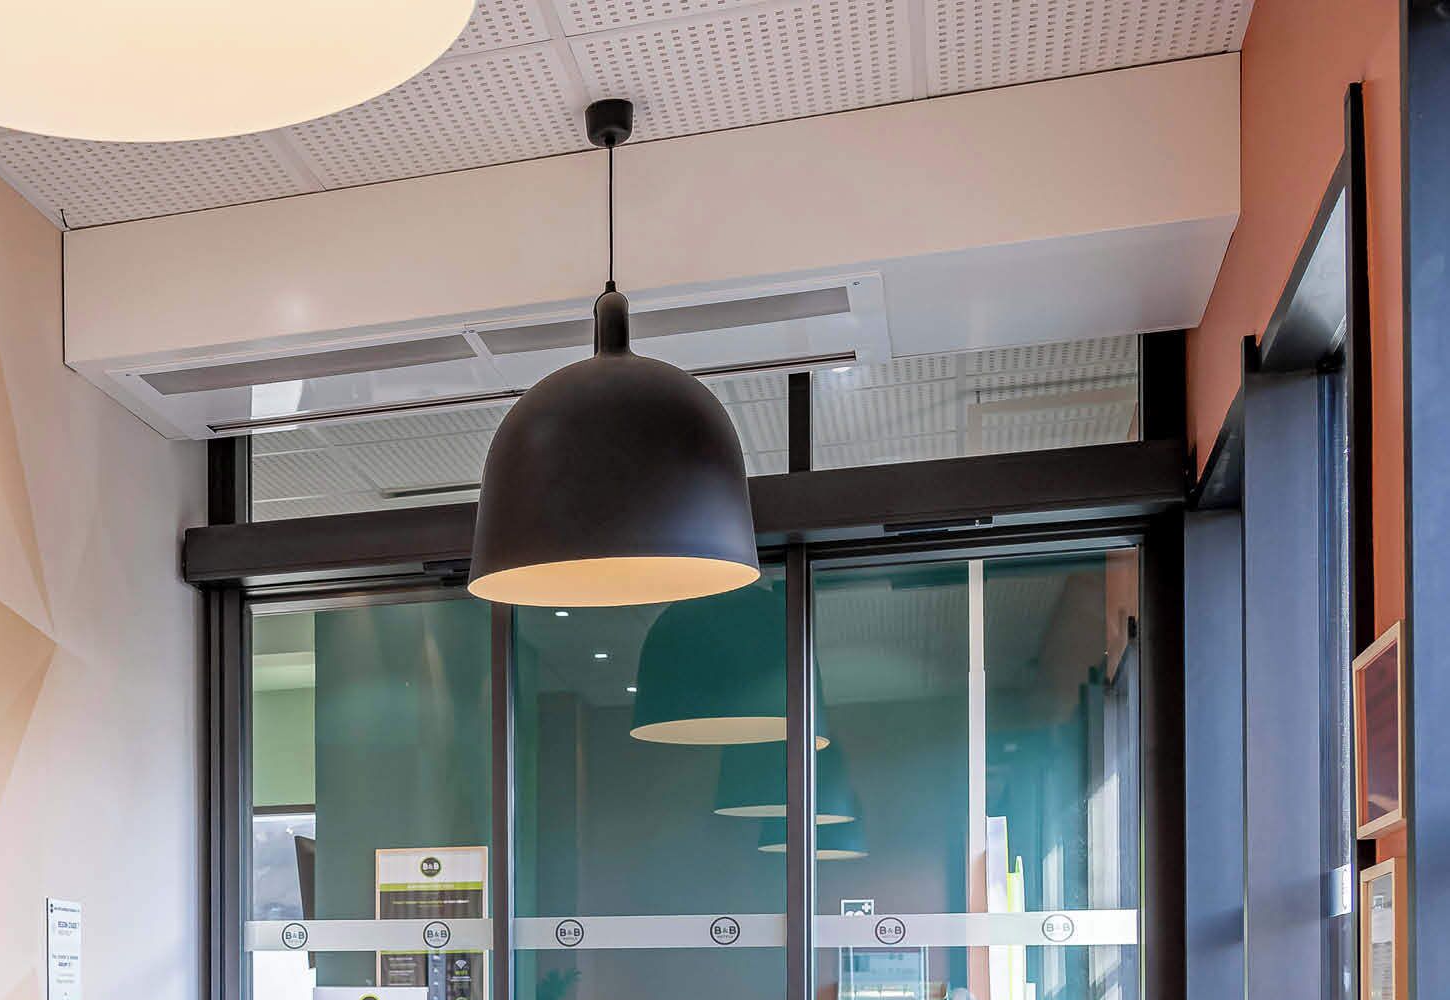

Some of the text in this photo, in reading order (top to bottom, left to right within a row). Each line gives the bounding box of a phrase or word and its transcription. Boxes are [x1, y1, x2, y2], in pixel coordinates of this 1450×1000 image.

[427, 930, 447, 938] B&B
[560, 928, 580, 936] B&B
[714, 926, 736, 935] B&B
[879, 926, 902, 935] B&B
[286, 932, 304, 940] B&B
